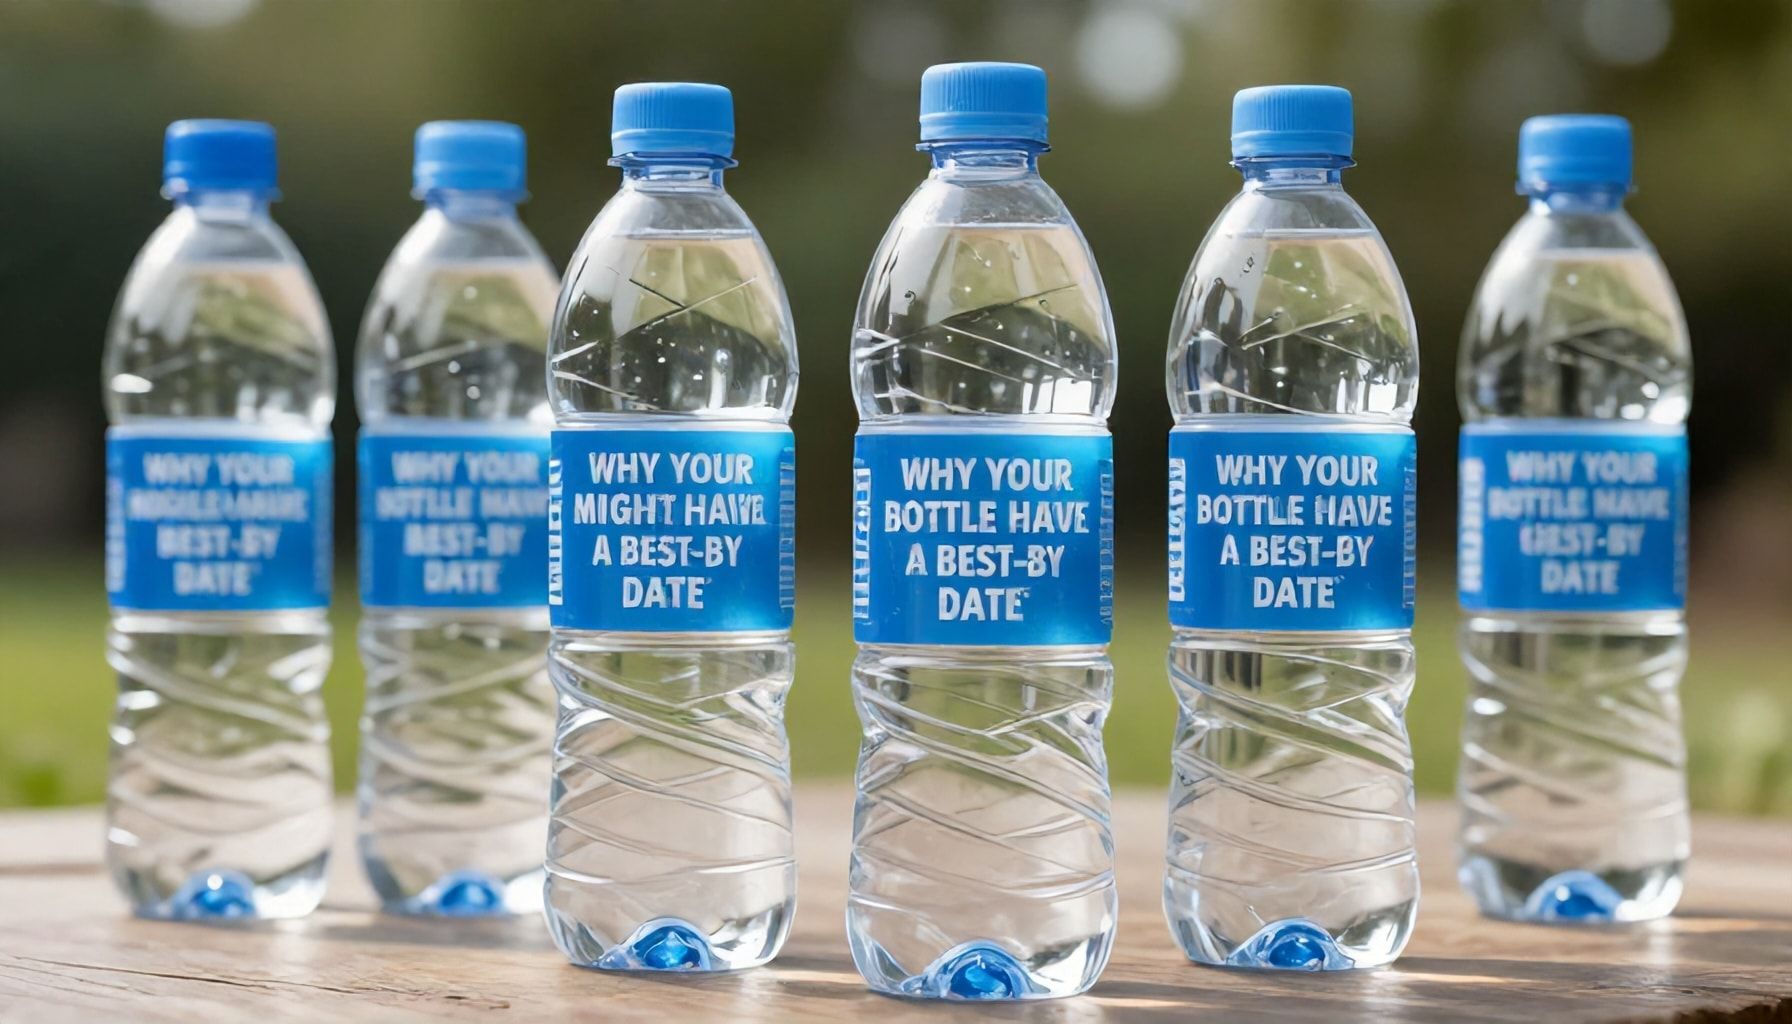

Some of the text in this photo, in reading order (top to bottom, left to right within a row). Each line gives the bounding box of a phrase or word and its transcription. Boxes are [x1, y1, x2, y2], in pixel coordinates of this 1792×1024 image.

[215, 453, 294, 486] YOUR
[464, 451, 540, 483] YOUR
[588, 452, 754, 484] WHY YOUR
[900, 457, 1074, 491] WHY YOUR
[1216, 454, 1379, 487] WHY YOUR
[1506, 450, 1657, 483] WHY YOUR
[573, 493, 676, 525] MIGHT
[884, 500, 1090, 534] BOTTLE HAVE
[1197, 494, 1392, 527] BOTTLE HAVE
[592, 534, 743, 567] A BEST-BY
[905, 543, 1065, 578] A BEST-BY
[1220, 534, 1374, 567] A BEST-BY
[622, 576, 706, 609] DATE
[1253, 576, 1336, 609] DATE
[1541, 560, 1621, 594] DATE
[938, 586, 1026, 621] DATE
